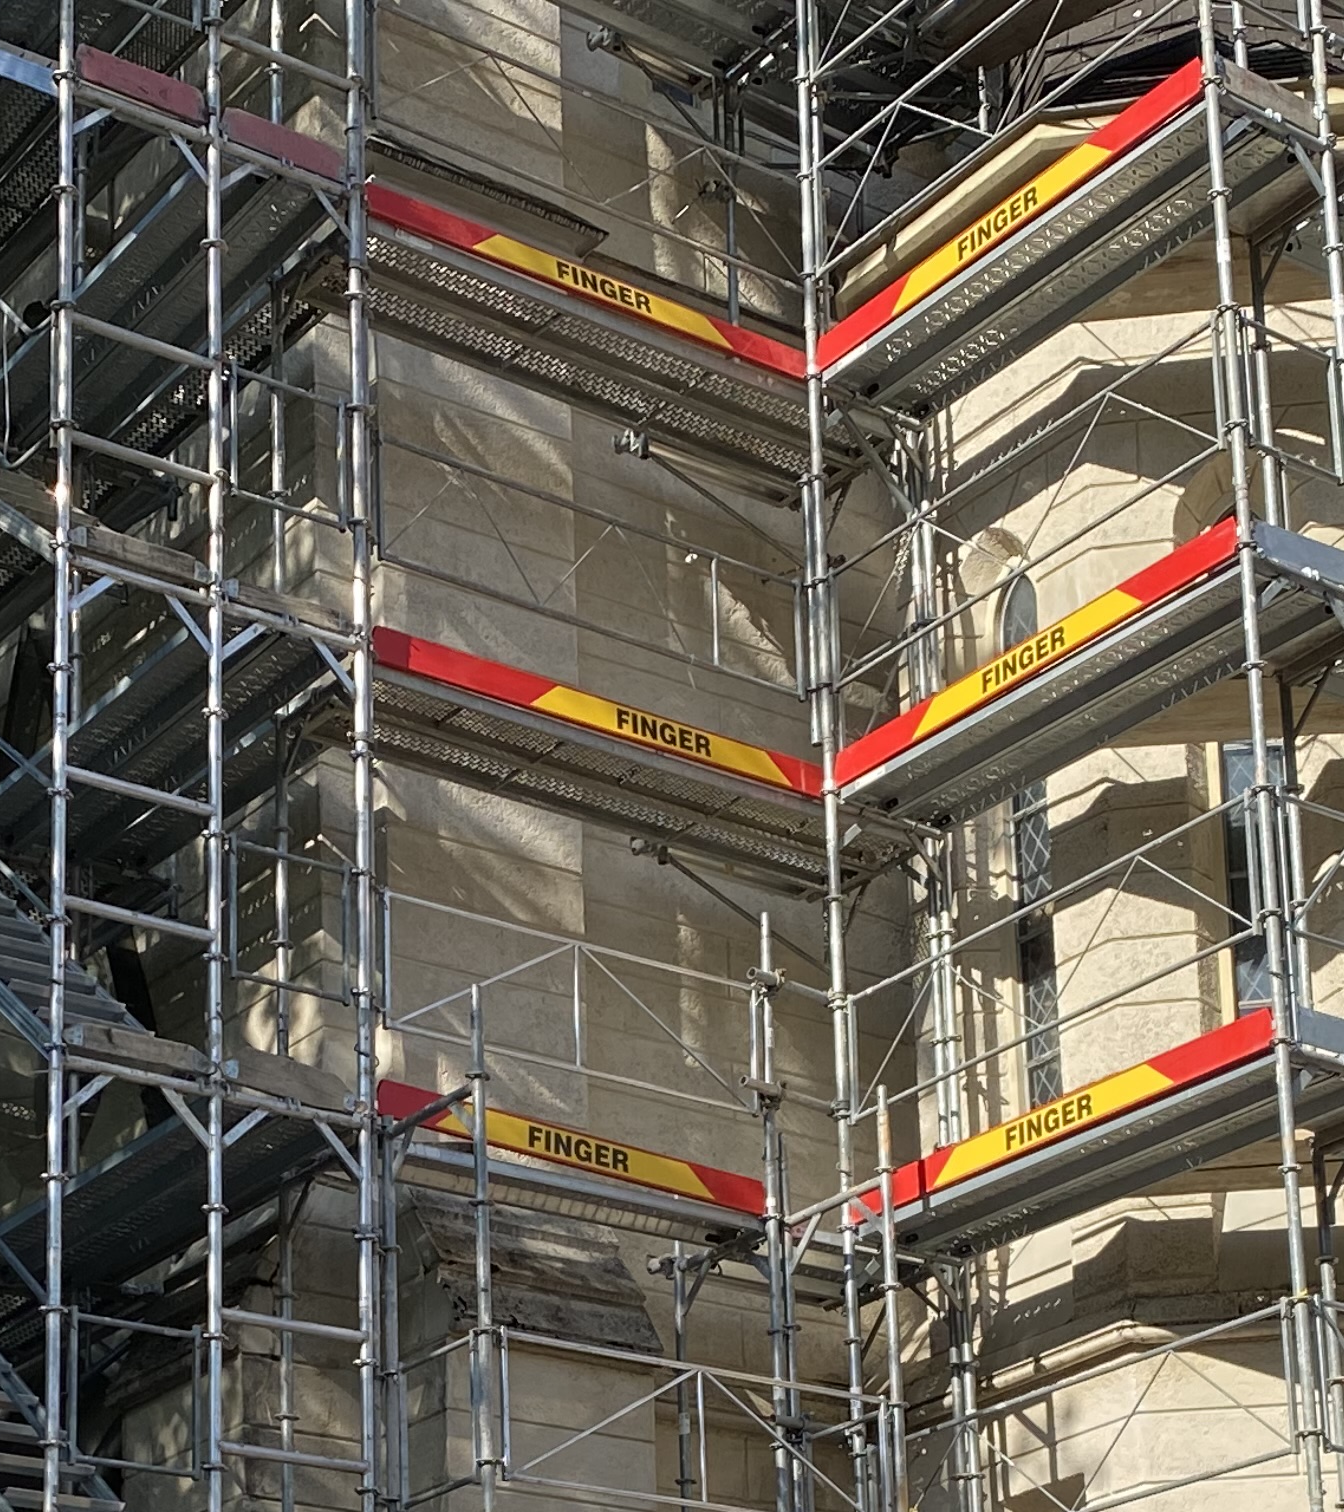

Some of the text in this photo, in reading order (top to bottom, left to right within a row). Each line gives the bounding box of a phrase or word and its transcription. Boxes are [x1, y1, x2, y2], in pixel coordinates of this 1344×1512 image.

[957, 185, 1039, 262] FINGER
[557, 260, 653, 314] FINGER
[981, 625, 1066, 694] FINGER
[616, 706, 712, 758] FINGER
[526, 1124, 630, 1174] FINGER
[1004, 1092, 1094, 1154] FINGER
